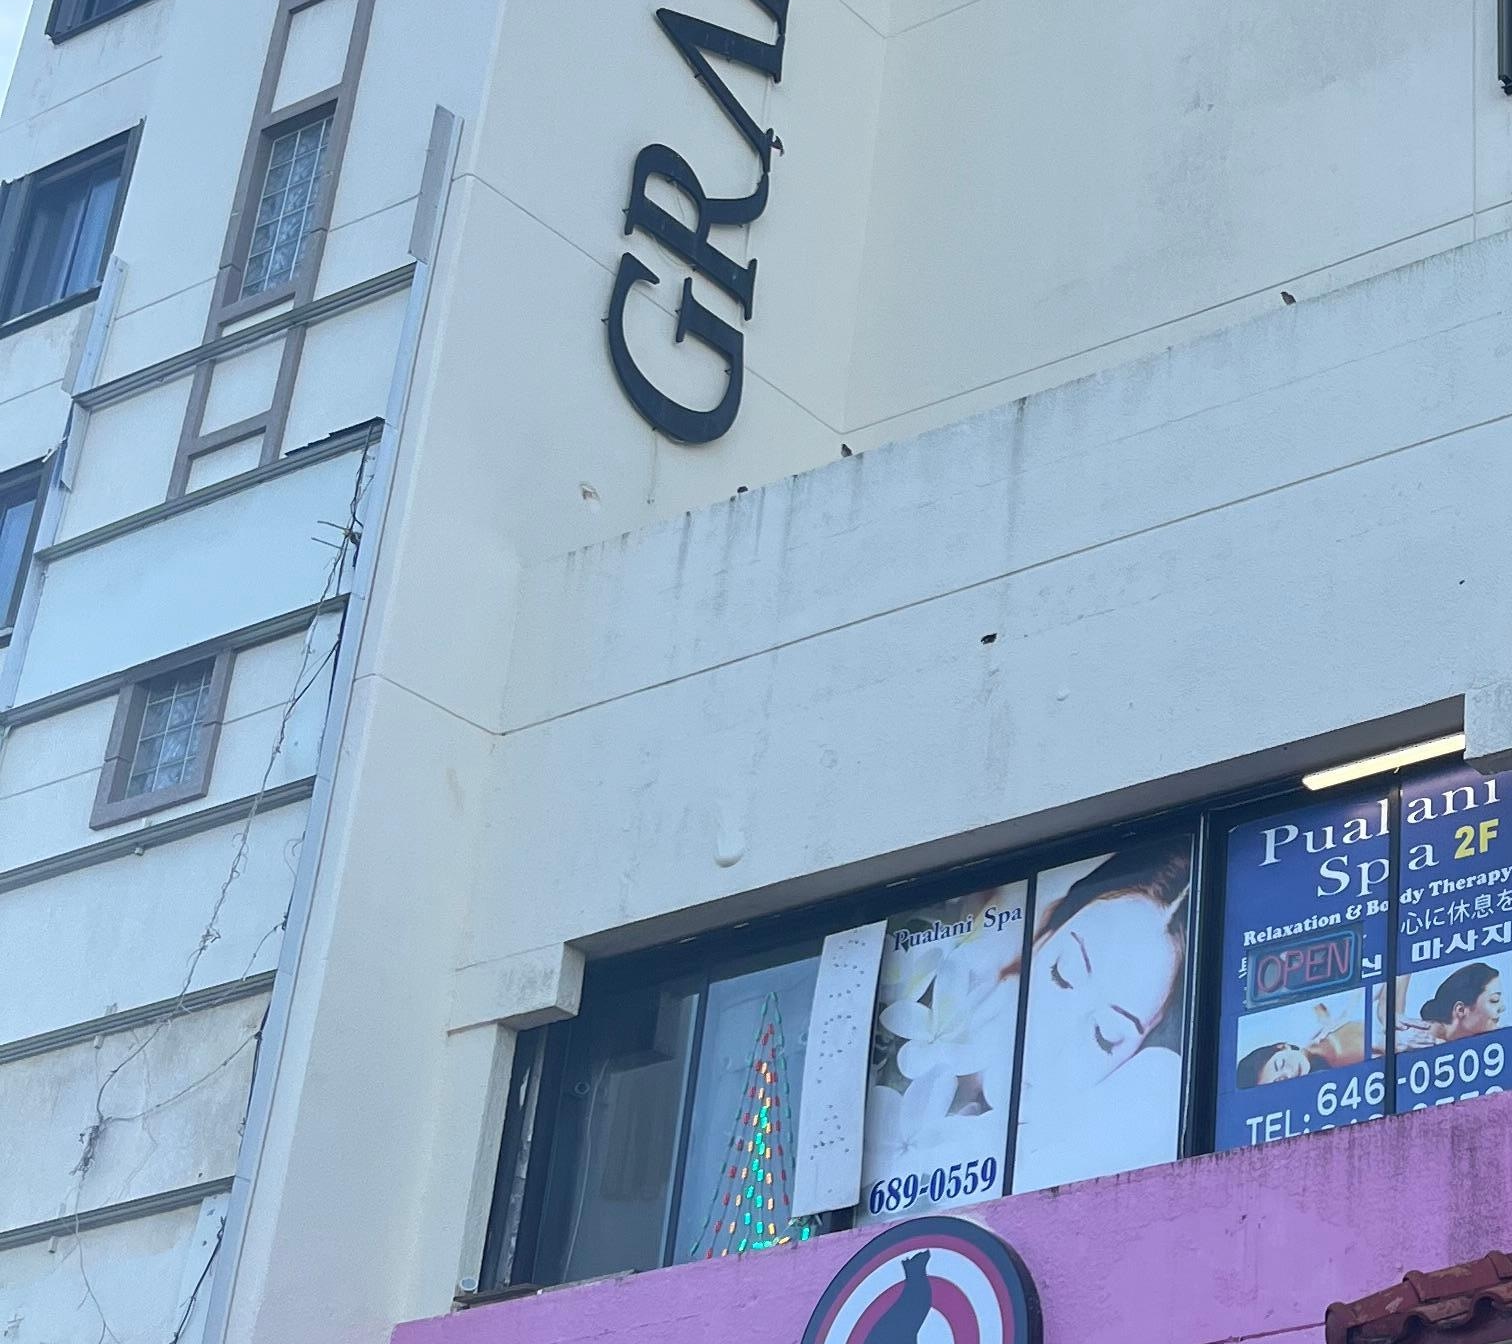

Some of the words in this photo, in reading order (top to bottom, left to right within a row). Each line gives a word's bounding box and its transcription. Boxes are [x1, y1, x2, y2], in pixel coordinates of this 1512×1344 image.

[1260, 779, 1500, 866] Pualani
[1317, 842, 1439, 897] Spa
[1454, 818, 1499, 860] 2F
[893, 916, 972, 952] Pualani
[984, 905, 1022, 932] Spa
[1243, 908, 1341, 946] Relaxation
[1345, 902, 1363, 919] &
[1366, 886, 1424, 917] Body
[1429, 864, 1512, 899] Therapy
[1257, 939, 1350, 993] OPEN
[1411, 921, 1512, 963] 마사지
[1317, 1042, 1505, 1116] 646-0509
[869, 1156, 997, 1215] 689-0559
